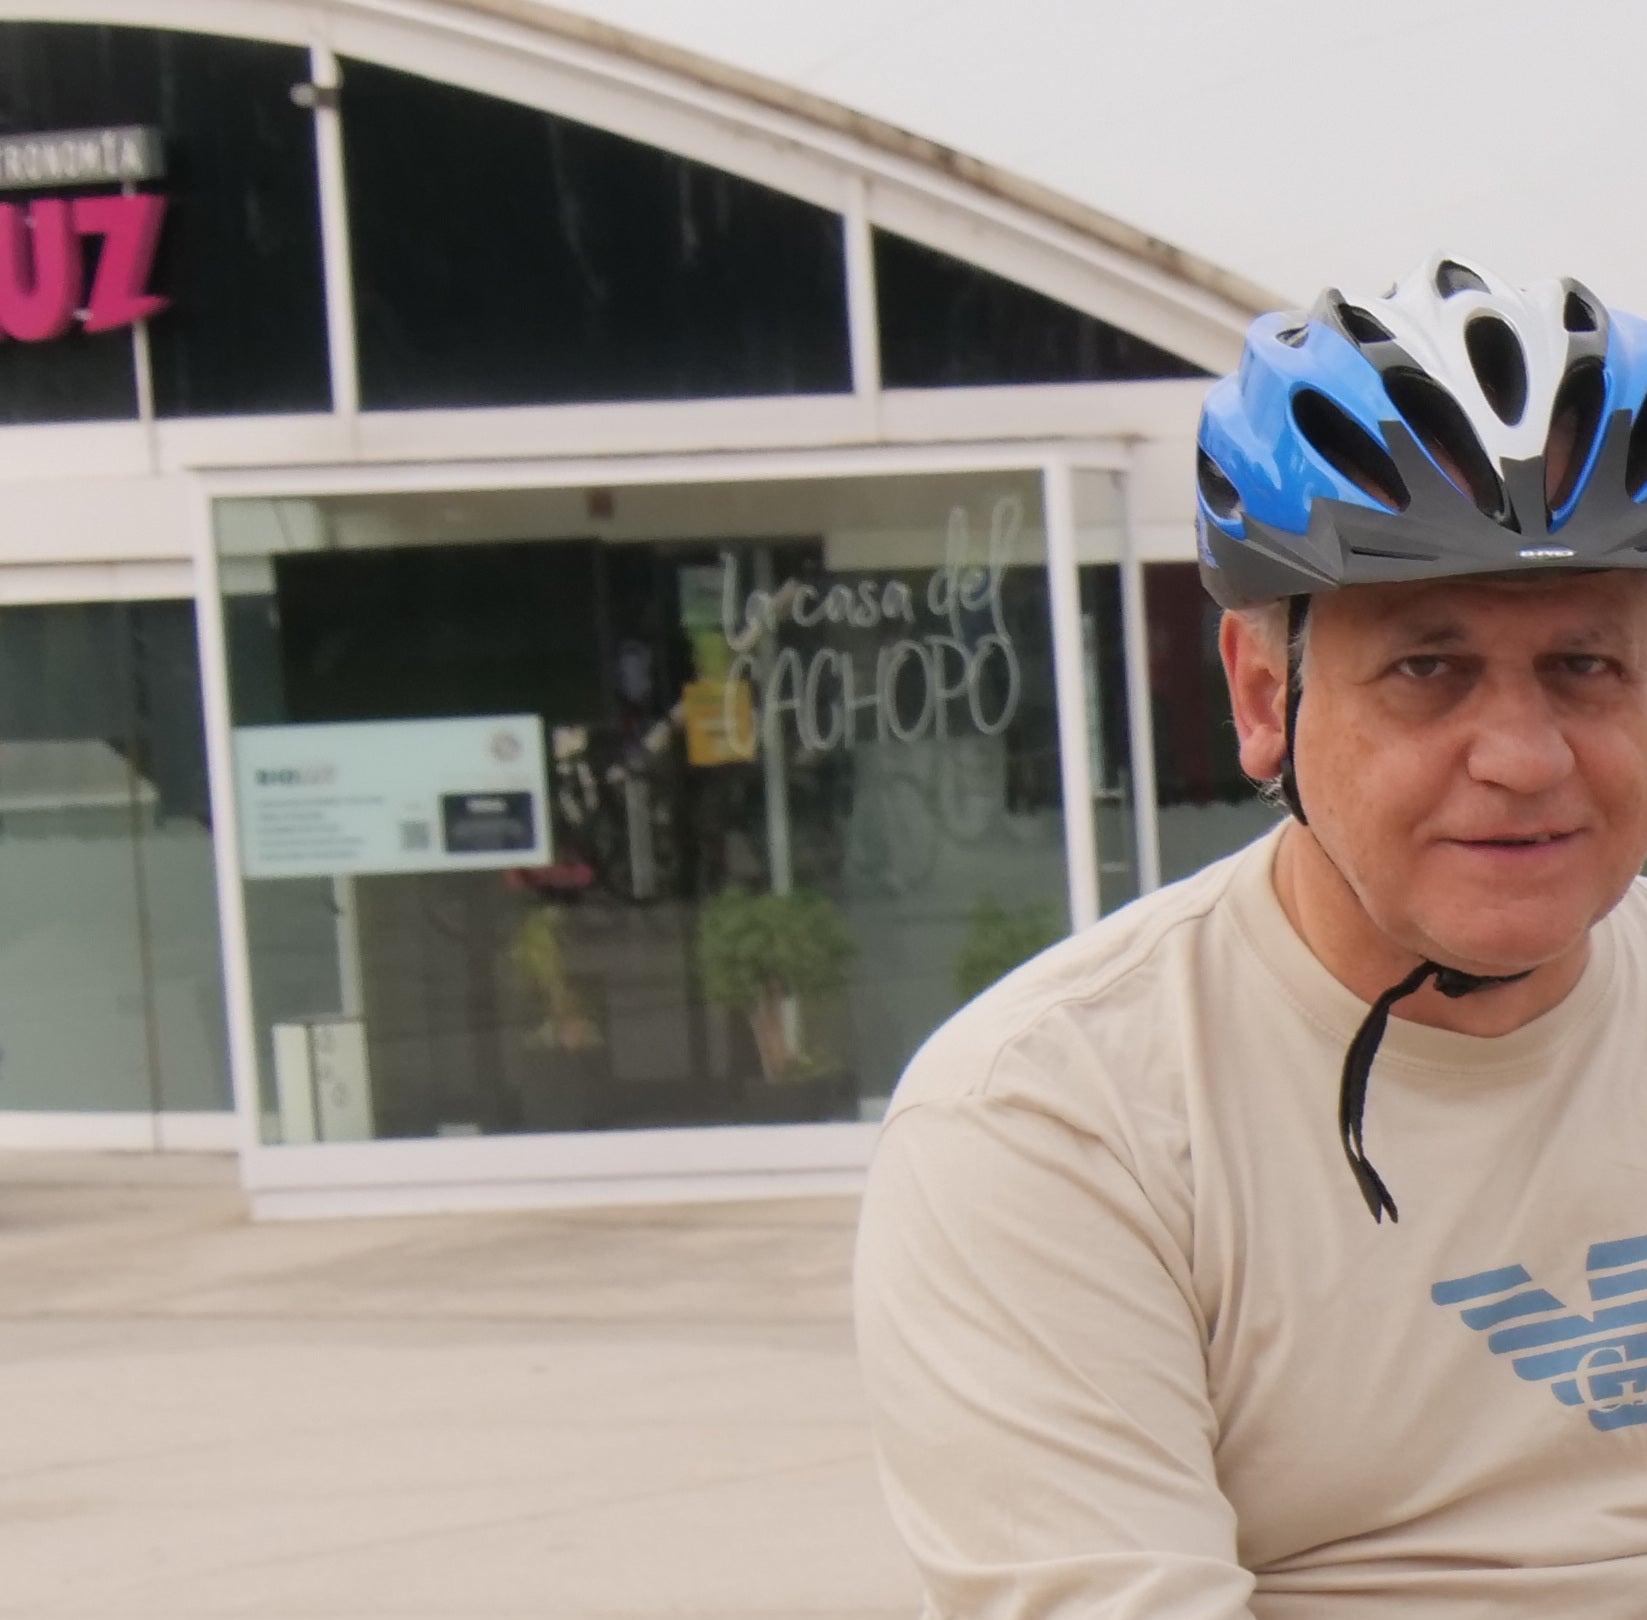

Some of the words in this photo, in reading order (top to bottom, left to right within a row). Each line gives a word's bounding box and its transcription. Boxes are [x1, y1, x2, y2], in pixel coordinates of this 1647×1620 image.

[791, 577, 915, 628] casa
[926, 498, 1022, 643] del
[723, 635, 1021, 758] CACHOPO
